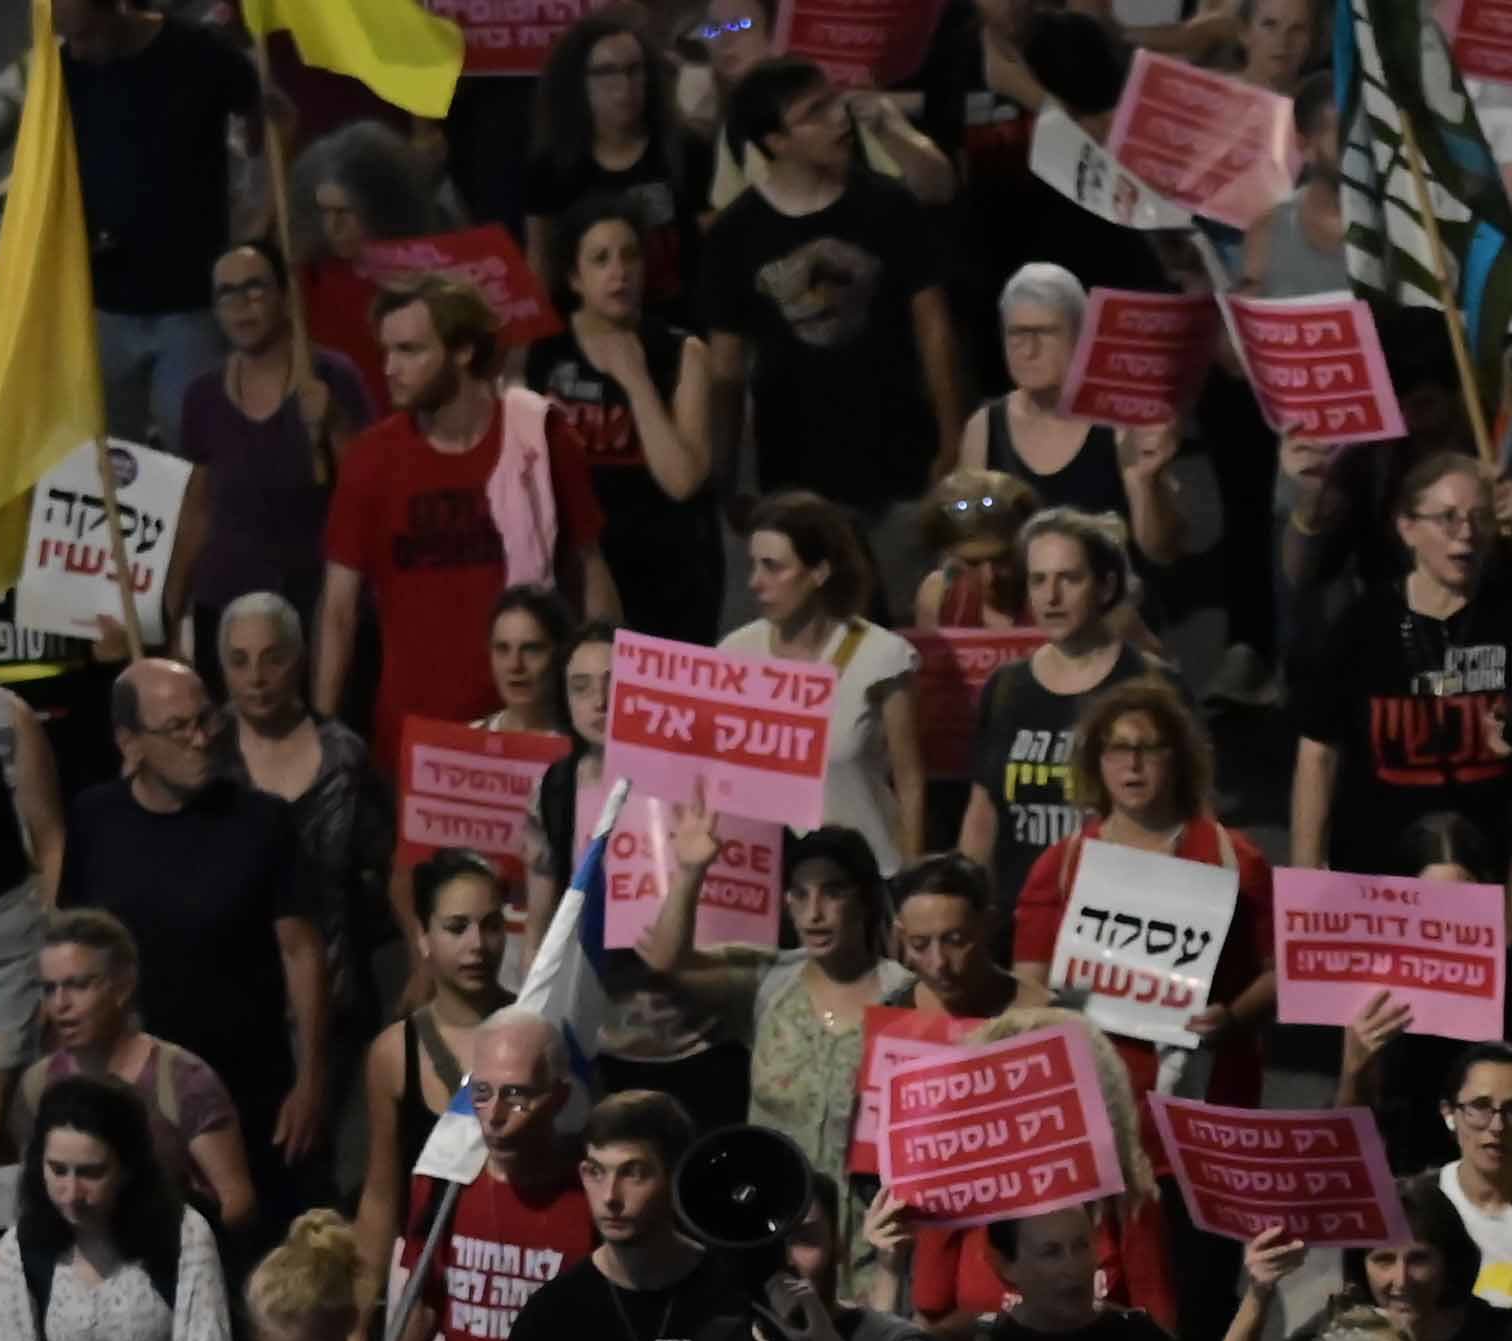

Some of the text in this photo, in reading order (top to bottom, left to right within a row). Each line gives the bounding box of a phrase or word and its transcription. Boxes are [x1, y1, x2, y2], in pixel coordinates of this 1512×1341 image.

[764, 668, 833, 708] קול
[620, 696, 815, 762] זועק אלי
[1075, 905, 1210, 967] עסקה
[1285, 909, 1495, 946] נשים דורשות
[1296, 948, 1486, 987] עסקה עכשיו!
[1007, 1051, 1052, 1086] רק
[1020, 1103, 1065, 1139] רק
[1295, 1126, 1340, 1155] רק
[1029, 1158, 1079, 1196] רק
[1305, 1170, 1352, 1194] רק
